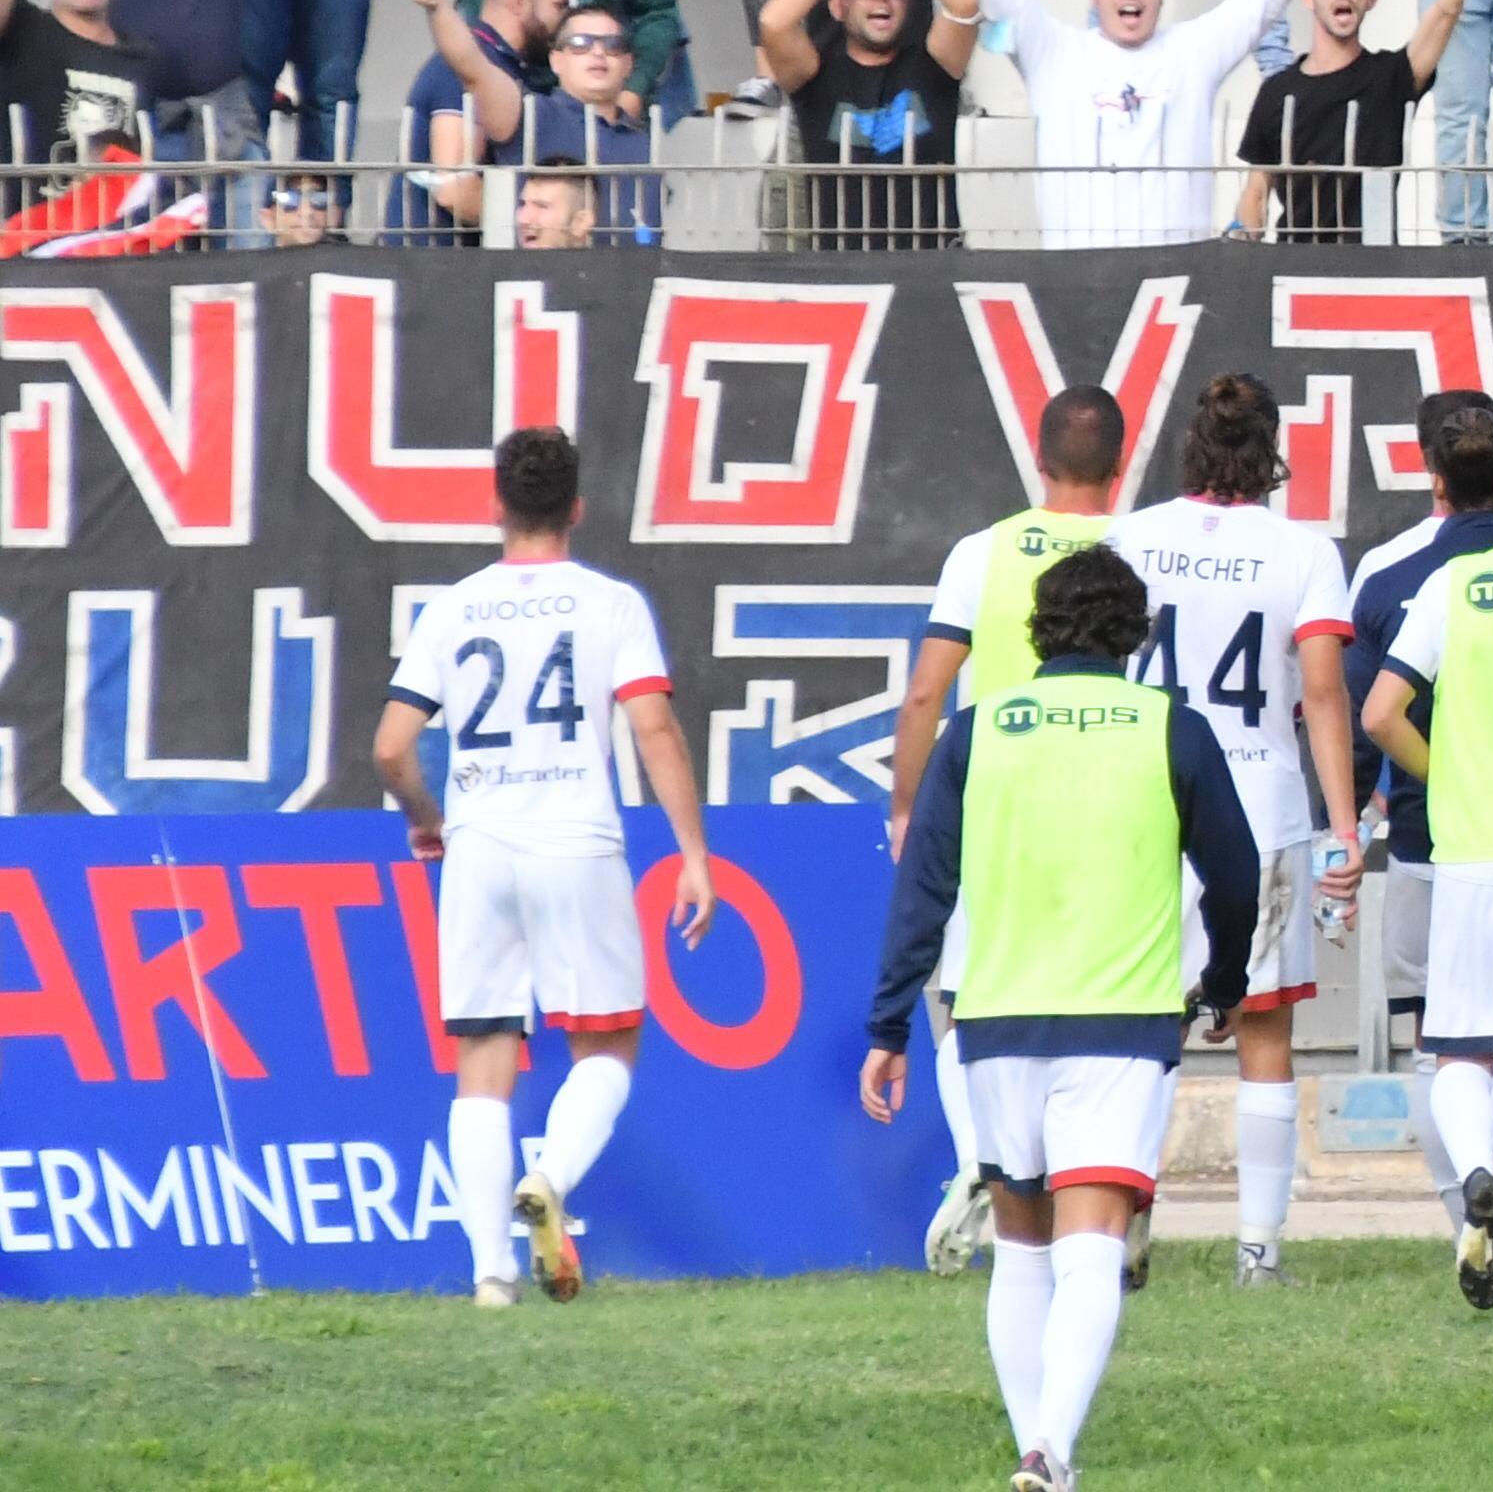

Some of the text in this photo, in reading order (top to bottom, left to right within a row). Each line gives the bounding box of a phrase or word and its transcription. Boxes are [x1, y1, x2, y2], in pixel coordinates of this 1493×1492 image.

[1143, 549, 1264, 583] TURCHET
[464, 595, 576, 623] RUOCCO
[455, 630, 585, 751] 24
[1135, 603, 1268, 728] 44
